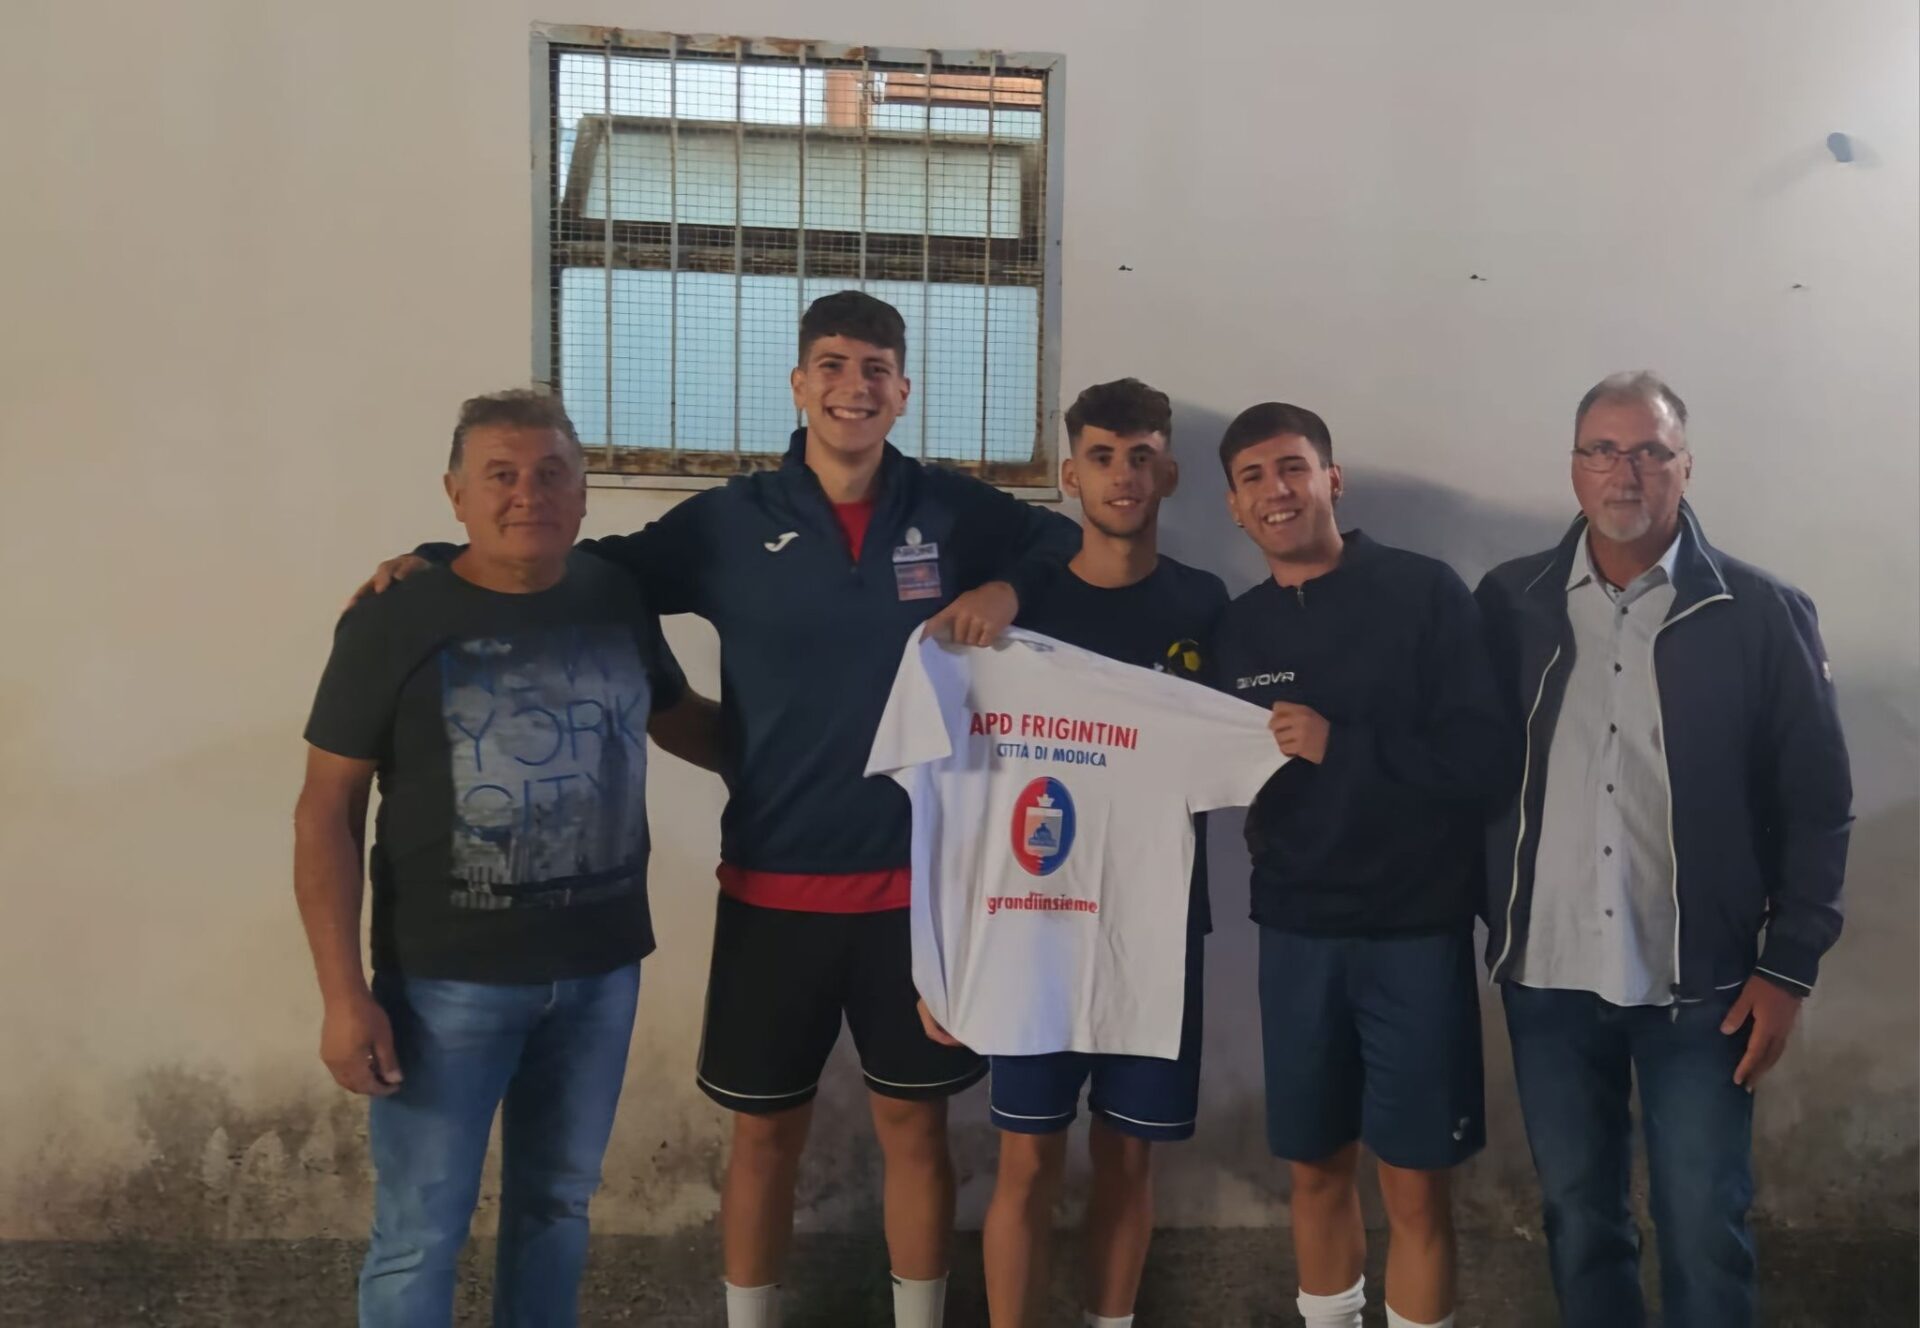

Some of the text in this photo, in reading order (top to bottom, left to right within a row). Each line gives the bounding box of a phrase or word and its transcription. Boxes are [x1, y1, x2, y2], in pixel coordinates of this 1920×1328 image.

[969, 712, 1138, 750] APD FRIGINTINI
[1034, 745, 1048, 760] DI
[1052, 747, 1107, 767] MODICA
[462, 772, 604, 841] CIT
